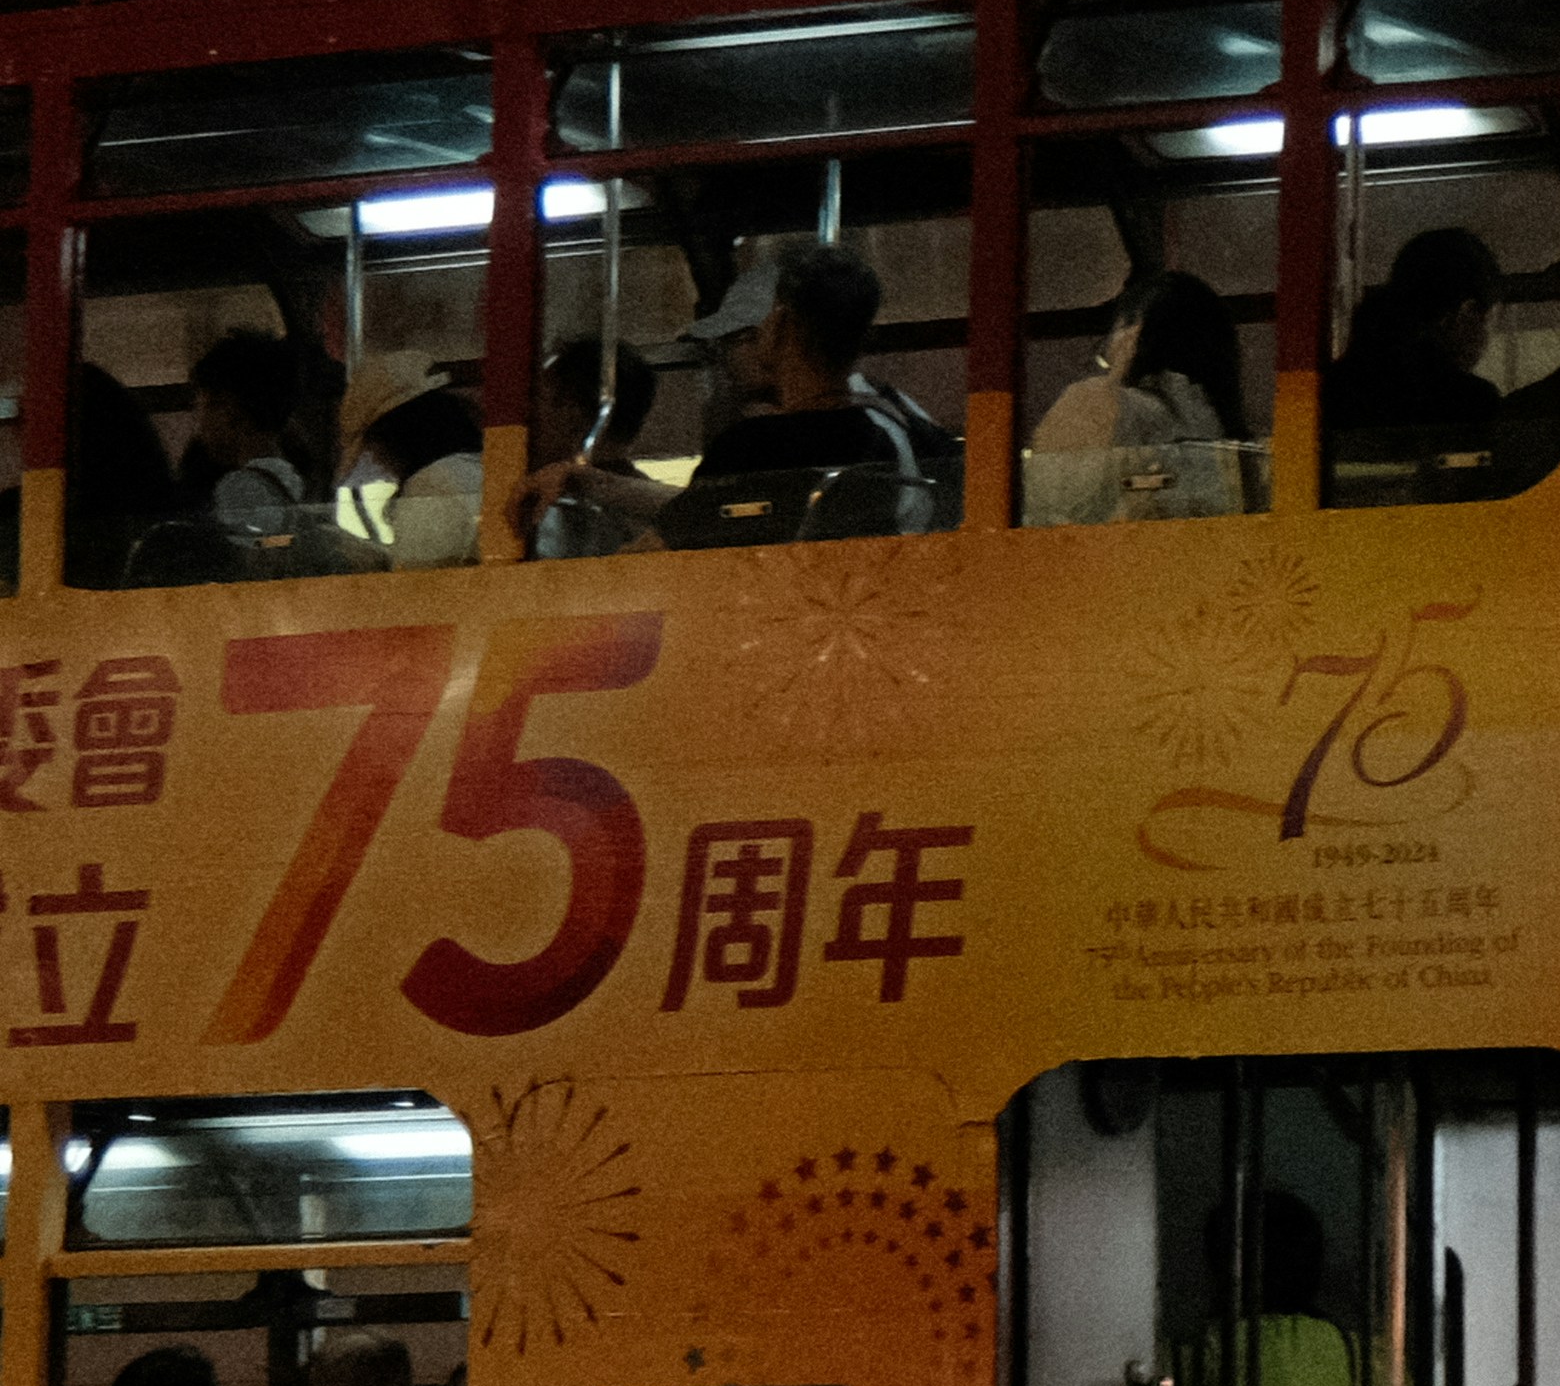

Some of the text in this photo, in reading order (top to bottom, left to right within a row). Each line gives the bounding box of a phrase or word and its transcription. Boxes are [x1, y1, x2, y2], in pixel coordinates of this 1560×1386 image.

[199, 613, 664, 1038] 75
[659, 813, 975, 1012] 周年
[1138, 938, 1275, 968] Anniversary
[1283, 938, 1307, 962] of
[1317, 938, 1356, 961] the
[1367, 932, 1484, 962] Founding
[1494, 926, 1520, 952] of
[1112, 963, 1493, 1004] the People's Republic of China
